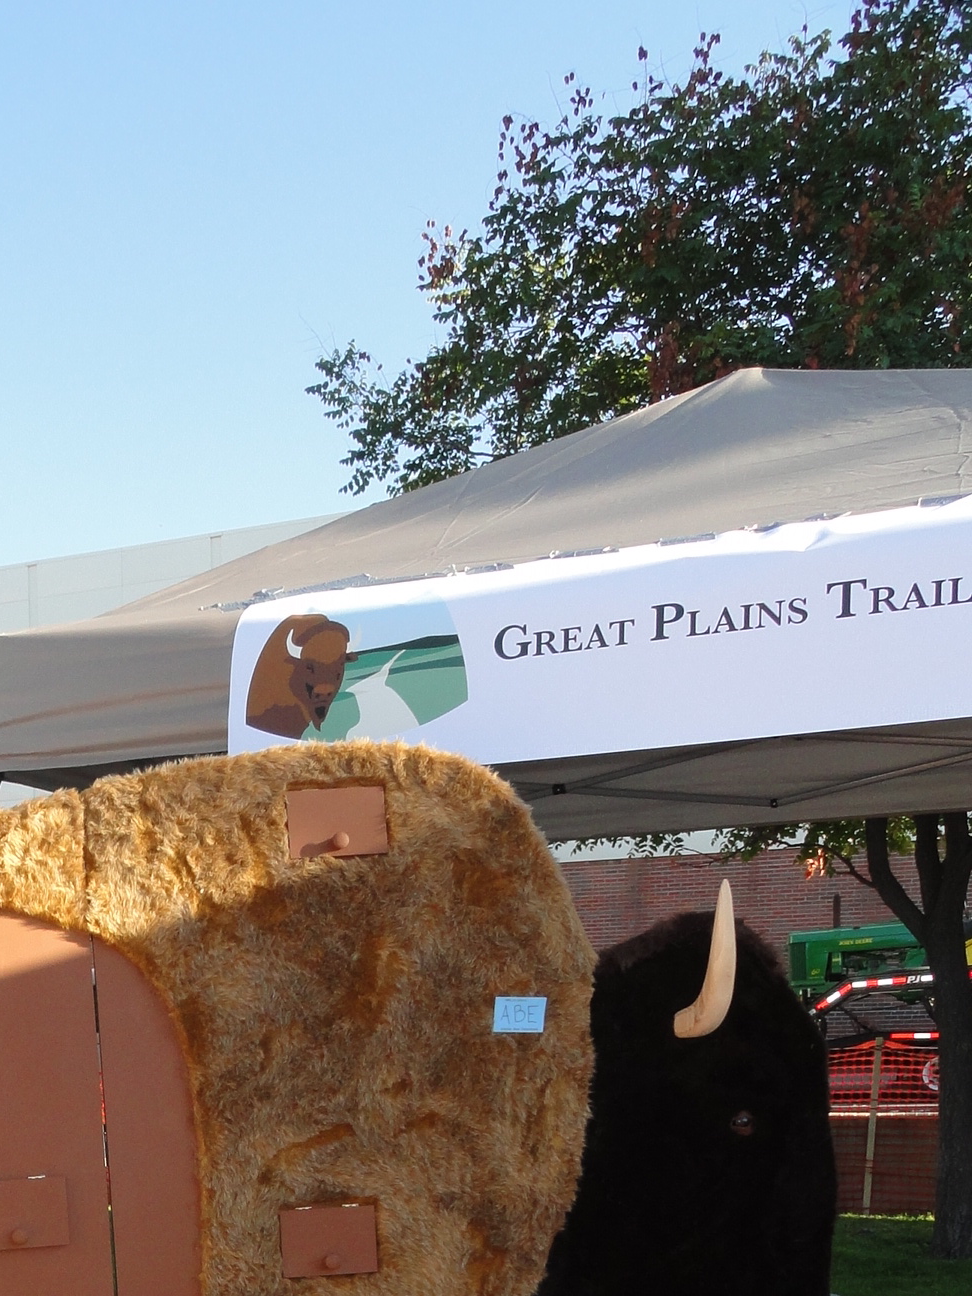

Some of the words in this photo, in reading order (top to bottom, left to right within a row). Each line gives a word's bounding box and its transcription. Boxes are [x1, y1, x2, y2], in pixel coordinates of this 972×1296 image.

[493, 619, 635, 661] GREAT
[650, 596, 809, 642] PLAINS
[826, 576, 972, 620] TRAIL
[907, 975, 921, 984] PJ
[500, 1004, 539, 1025] ABE
